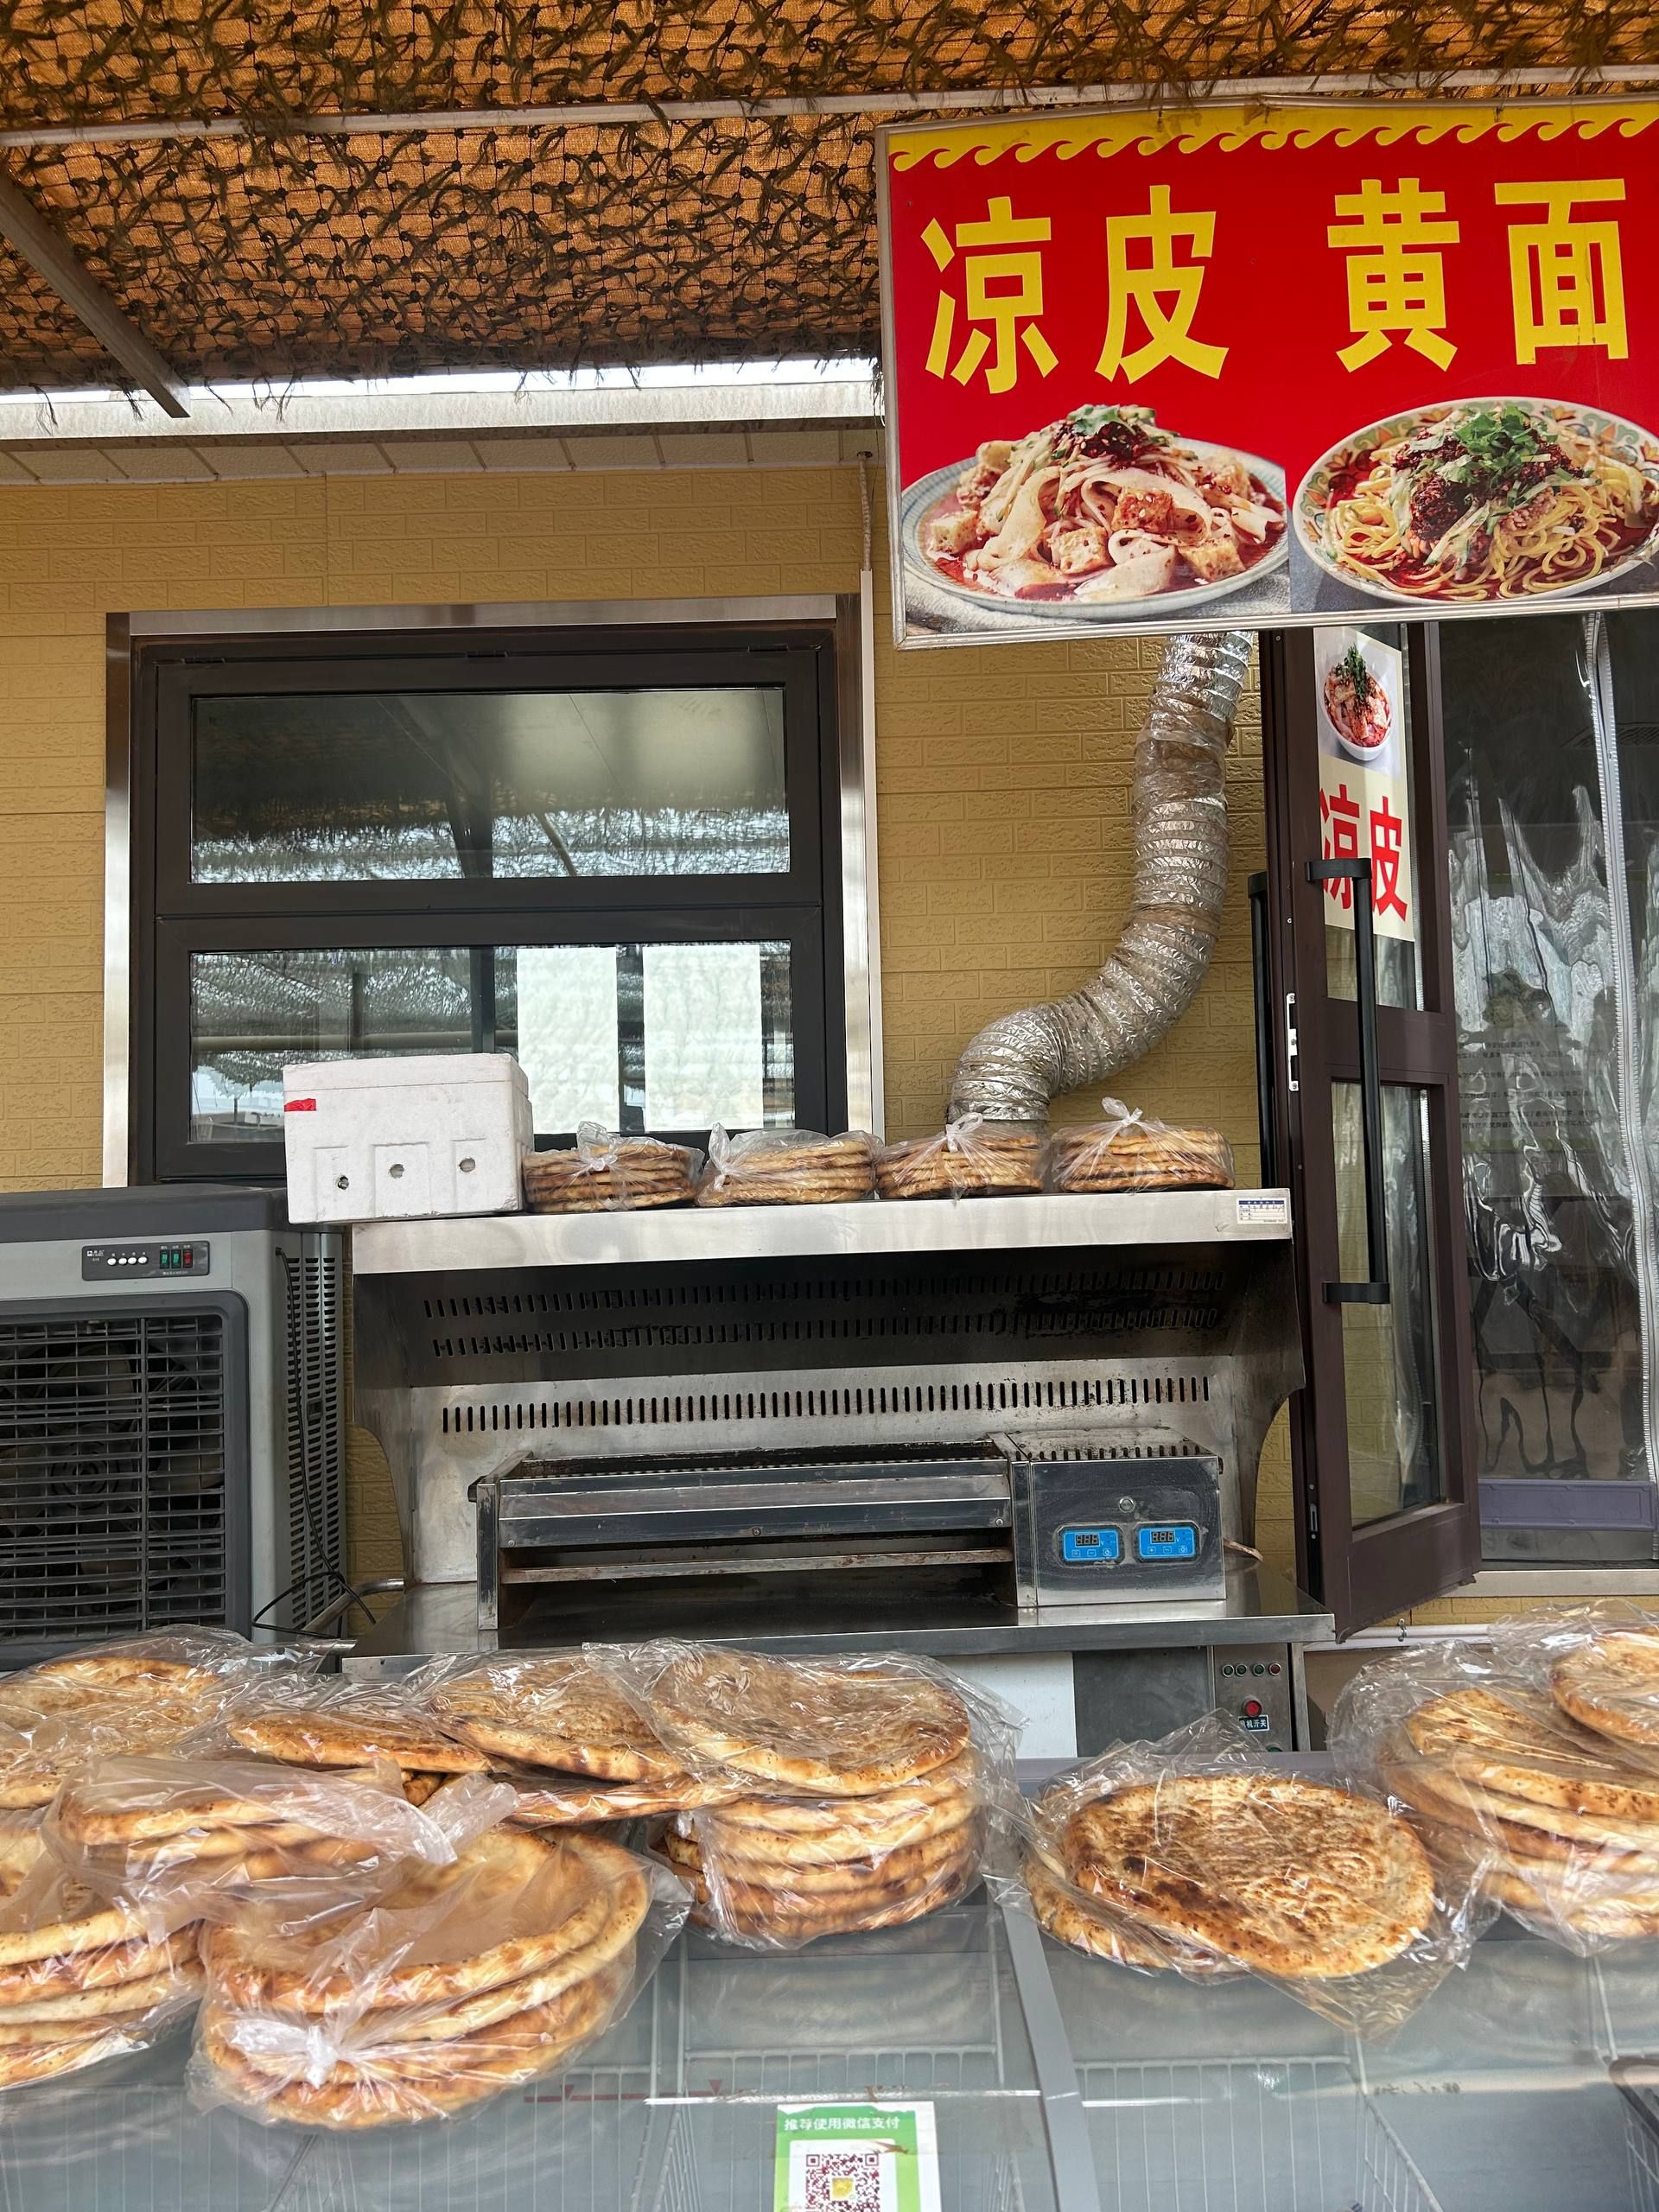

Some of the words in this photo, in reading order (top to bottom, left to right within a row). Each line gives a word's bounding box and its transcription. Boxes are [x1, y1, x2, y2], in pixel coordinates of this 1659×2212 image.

[921, 184, 1230, 395] 凉皮
[1327, 178, 1628, 373] 黄面
[1320, 784, 1408, 922] 凉皮
[785, 2116, 900, 2132] 推荐使用微信支付
